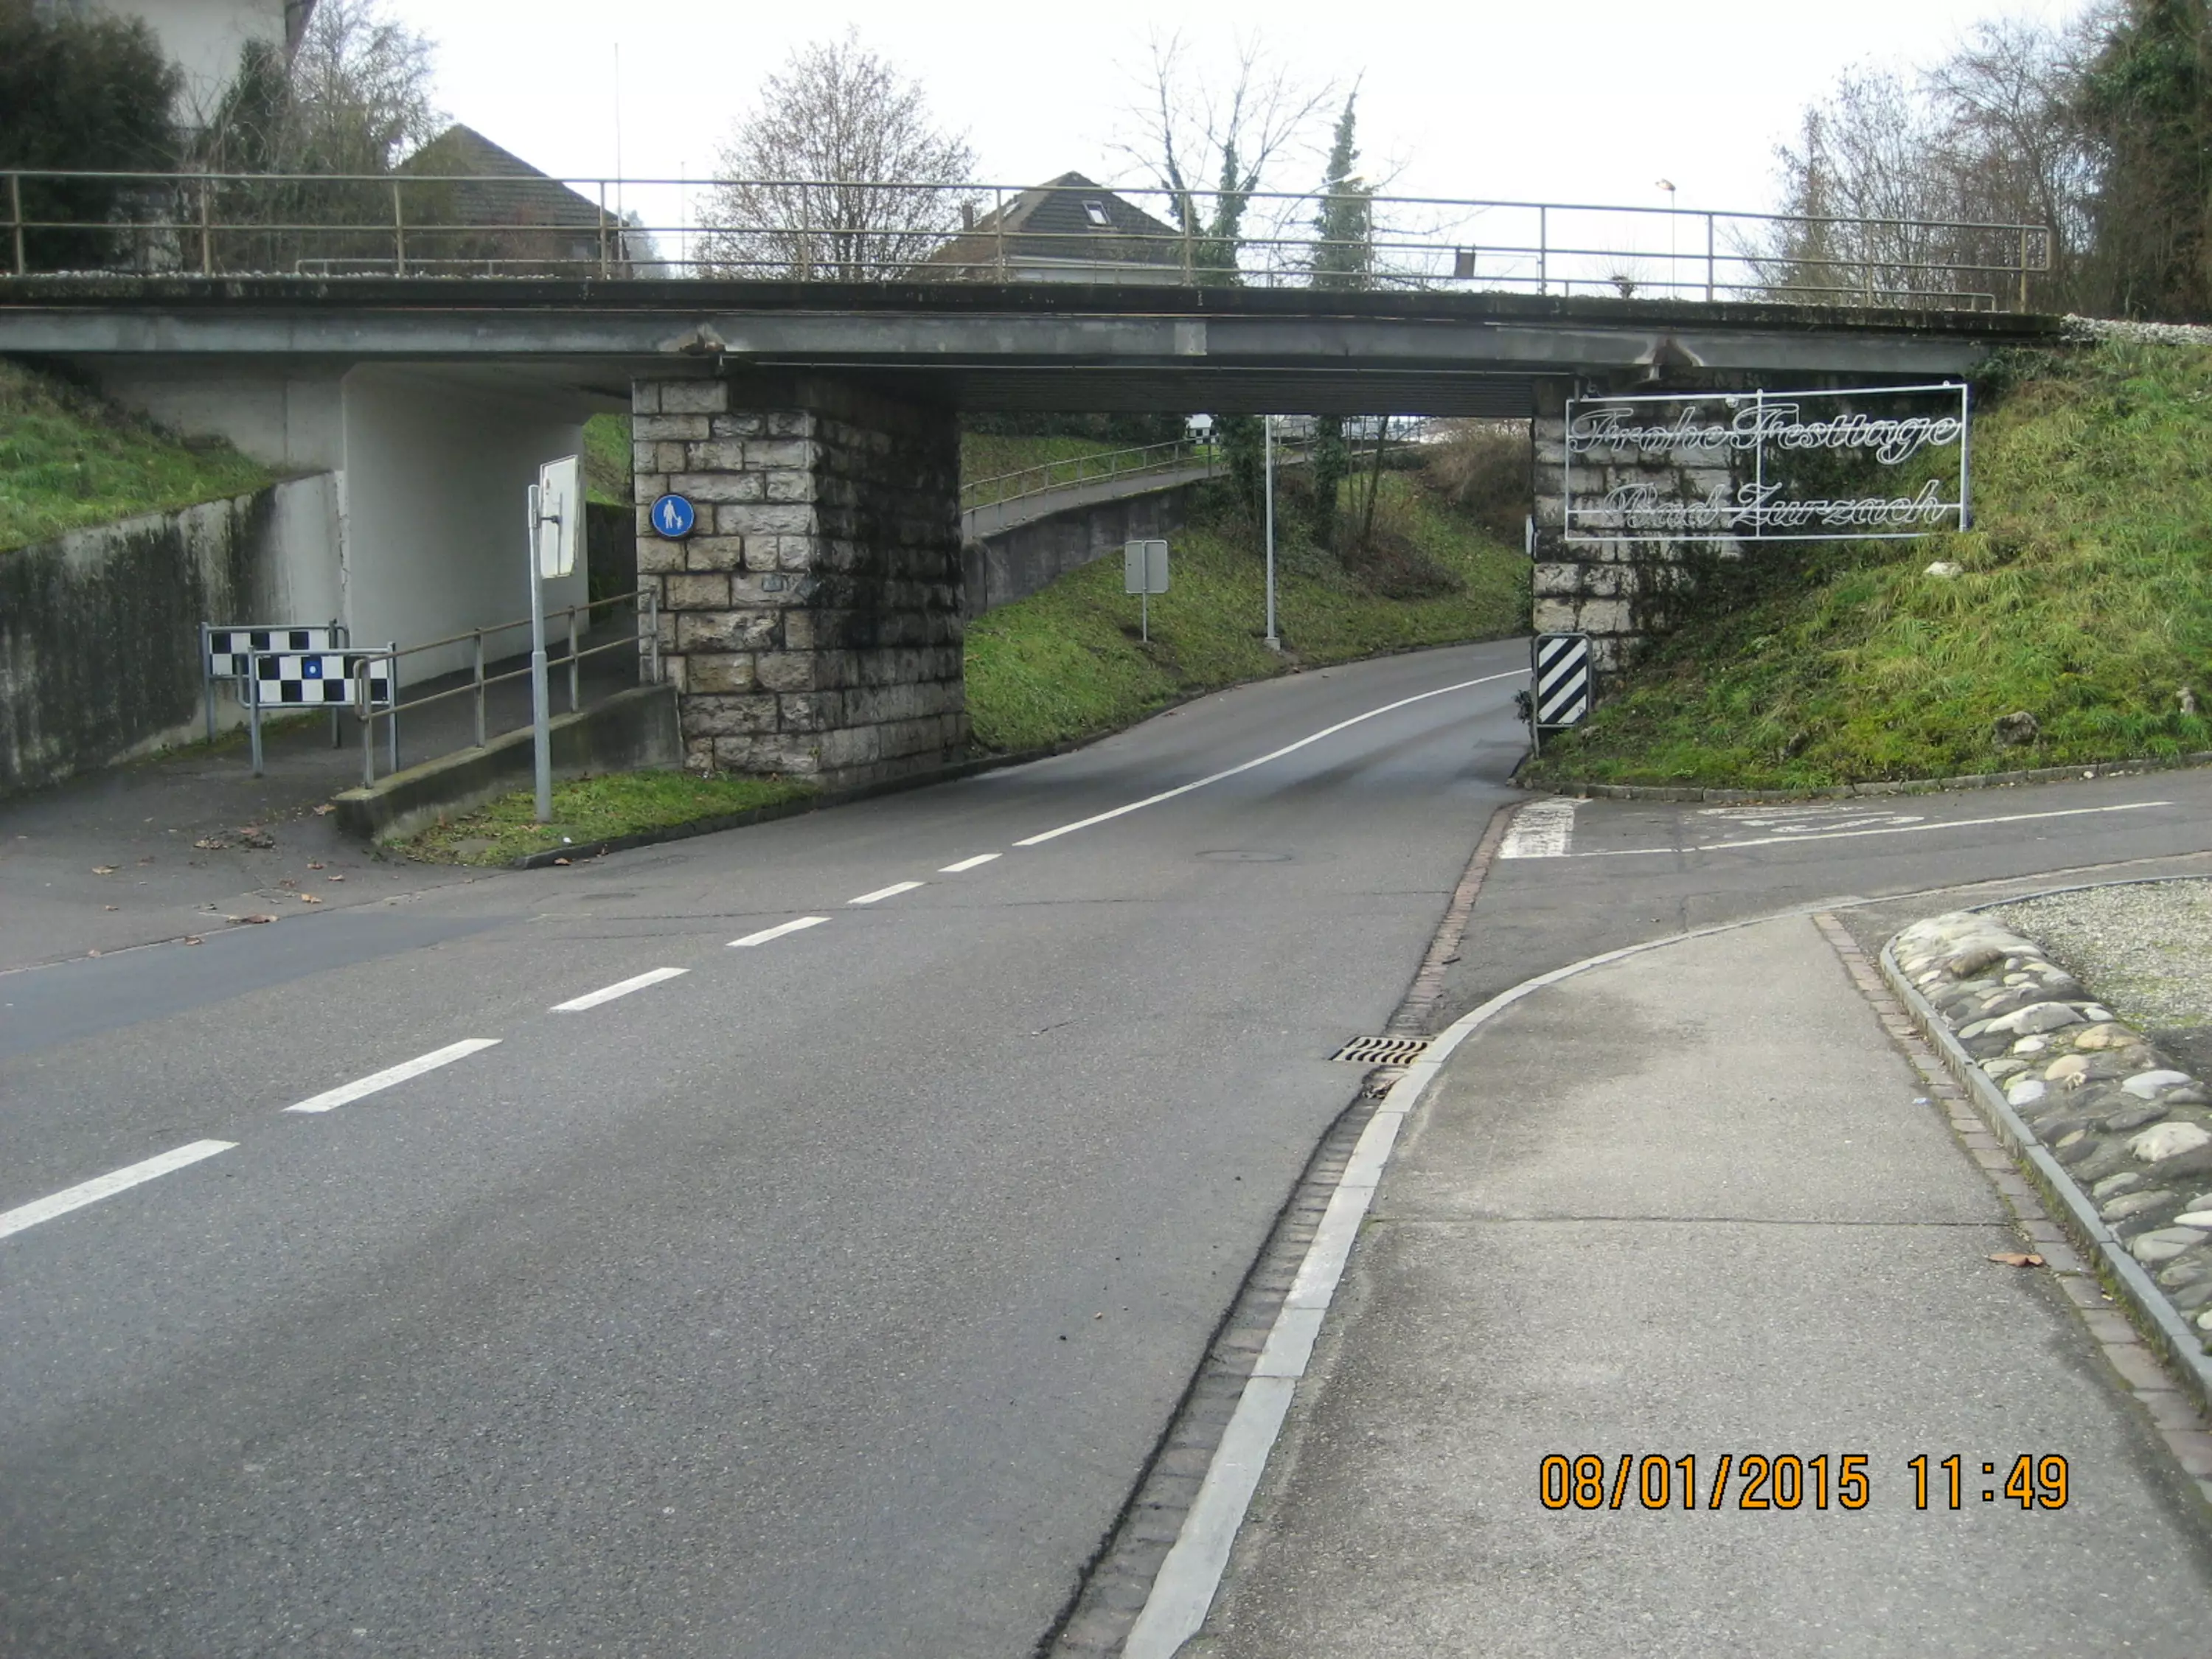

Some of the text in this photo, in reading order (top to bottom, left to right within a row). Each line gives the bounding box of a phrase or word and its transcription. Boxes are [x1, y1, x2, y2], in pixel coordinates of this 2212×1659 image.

[1568, 403, 1963, 465] Frohe Festtage
[1601, 479, 1948, 529] Bad Zurzach
